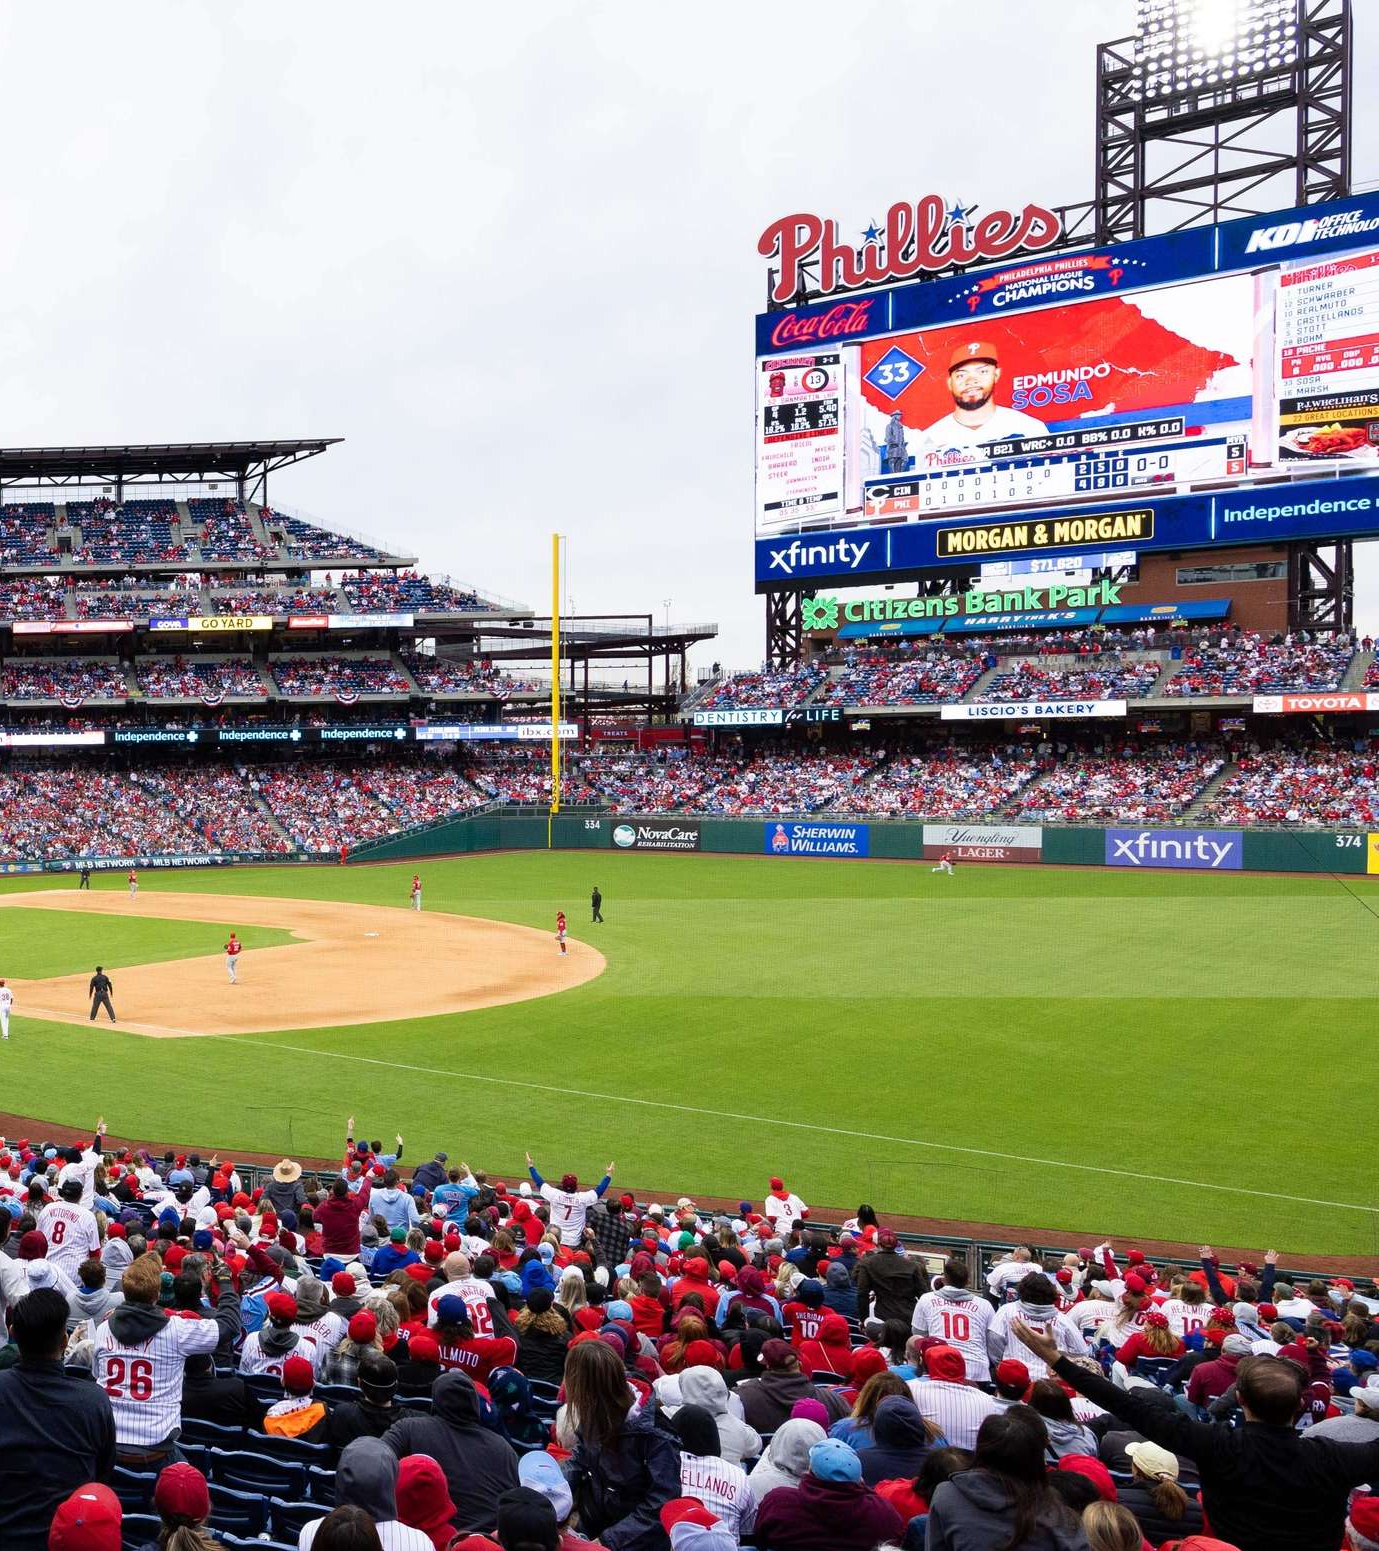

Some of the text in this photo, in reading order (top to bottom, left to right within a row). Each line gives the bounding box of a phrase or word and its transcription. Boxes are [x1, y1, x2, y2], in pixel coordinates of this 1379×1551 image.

[1244, 210, 1364, 254] KDI OFFICE
[757, 194, 1061, 302] Phillies
[999, 258, 1088, 282] PHILADELPHIA PHILLIES
[1005, 270, 1083, 291] NATIONAL LEAGUE
[1297, 282, 1333, 295] TURNER
[992, 275, 1095, 307] CHAMPIONS
[1297, 288, 1355, 306] SCHWARBER
[1297, 299, 1347, 315] REALMUTO
[1297, 307, 1364, 326] CASTELLANOS
[1297, 323, 1326, 335] STOTT
[1297, 334, 1323, 345] BOHM
[1309, 362, 1334, 373] .000
[1337, 357, 1363, 369] .000
[810, 375, 821, 385] 13
[878, 362, 910, 385] 33
[1012, 363, 1111, 391] EDMUNDO
[1296, 376, 1321, 385] SOSA
[1011, 380, 1093, 410] SOSA
[1296, 385, 1329, 395] MARSH
[1305, 412, 1329, 421] GREAT
[1332, 407, 1379, 418] LOCATIONS
[1056, 435, 1075, 448] 0.0
[1082, 431, 1108, 444] BB%
[1111, 428, 1131, 440] 0.0
[1138, 425, 1156, 437] K%
[1160, 421, 1180, 434] 0.0
[893, 486, 911, 496] CIN
[926, 483, 931, 492] 0
[942, 481, 947, 490] 0
[958, 479, 964, 488] 0
[975, 477, 981, 486] 0
[993, 475, 997, 484] 1
[1010, 473, 1014, 482] 1
[1027, 471, 1032, 480] 0
[1044, 469, 1050, 478] 0
[1079, 464, 1087, 474] 2
[1117, 460, 1124, 470] 0
[1137, 455, 1169, 472] 0-0
[894, 500, 910, 509] PHI
[926, 496, 931, 505] 0
[942, 495, 947, 504] 1
[958, 493, 964, 502] 0
[975, 491, 981, 500] 0
[993, 490, 997, 498] 1
[1009, 488, 1015, 496] 0
[1027, 486, 1032, 495] 2
[1079, 479, 1087, 489] 4
[1117, 475, 1124, 485] 0
[1224, 498, 1371, 522] Independence
[947, 515, 1142, 553] MORGAN & MORGAN
[769, 538, 870, 573] xfinity
[845, 579, 1122, 622] Citizens Bank Park
[202, 619, 218, 628] GO
[221, 618, 253, 628] YARD
[964, 614, 1023, 625] HARRY
[1048, 611, 1077, 620] K'S
[968, 703, 1095, 717] LISCIO'S BAKERY
[1288, 697, 1362, 710] TOYOTA
[695, 709, 840, 723] DENTISTRY for LIFE
[114, 731, 185, 742] Independence
[220, 729, 288, 740] Independence
[320, 728, 393, 739] Independence
[584, 820, 600, 830] 334
[792, 825, 856, 840] SHERWIN
[636, 827, 698, 841] NovaCare
[945, 827, 1017, 846] Yuengling
[1335, 835, 1362, 847] 374
[957, 847, 1005, 859] LAGER
[1113, 832, 1234, 866] xfinity
[95, 858, 135, 869] NETWORK
[153, 858, 170, 868] MLB
[171, 857, 211, 867] NETWORK
[563, 1204, 572, 1220] 7
[783, 1203, 793, 1216] 3
[52, 1221, 66, 1244] 8
[800, 1320, 818, 1338] 10
[940, 1311, 971, 1341] 10
[106, 1357, 153, 1401] 26
[682, 1470, 736, 1500] ELLANOS
